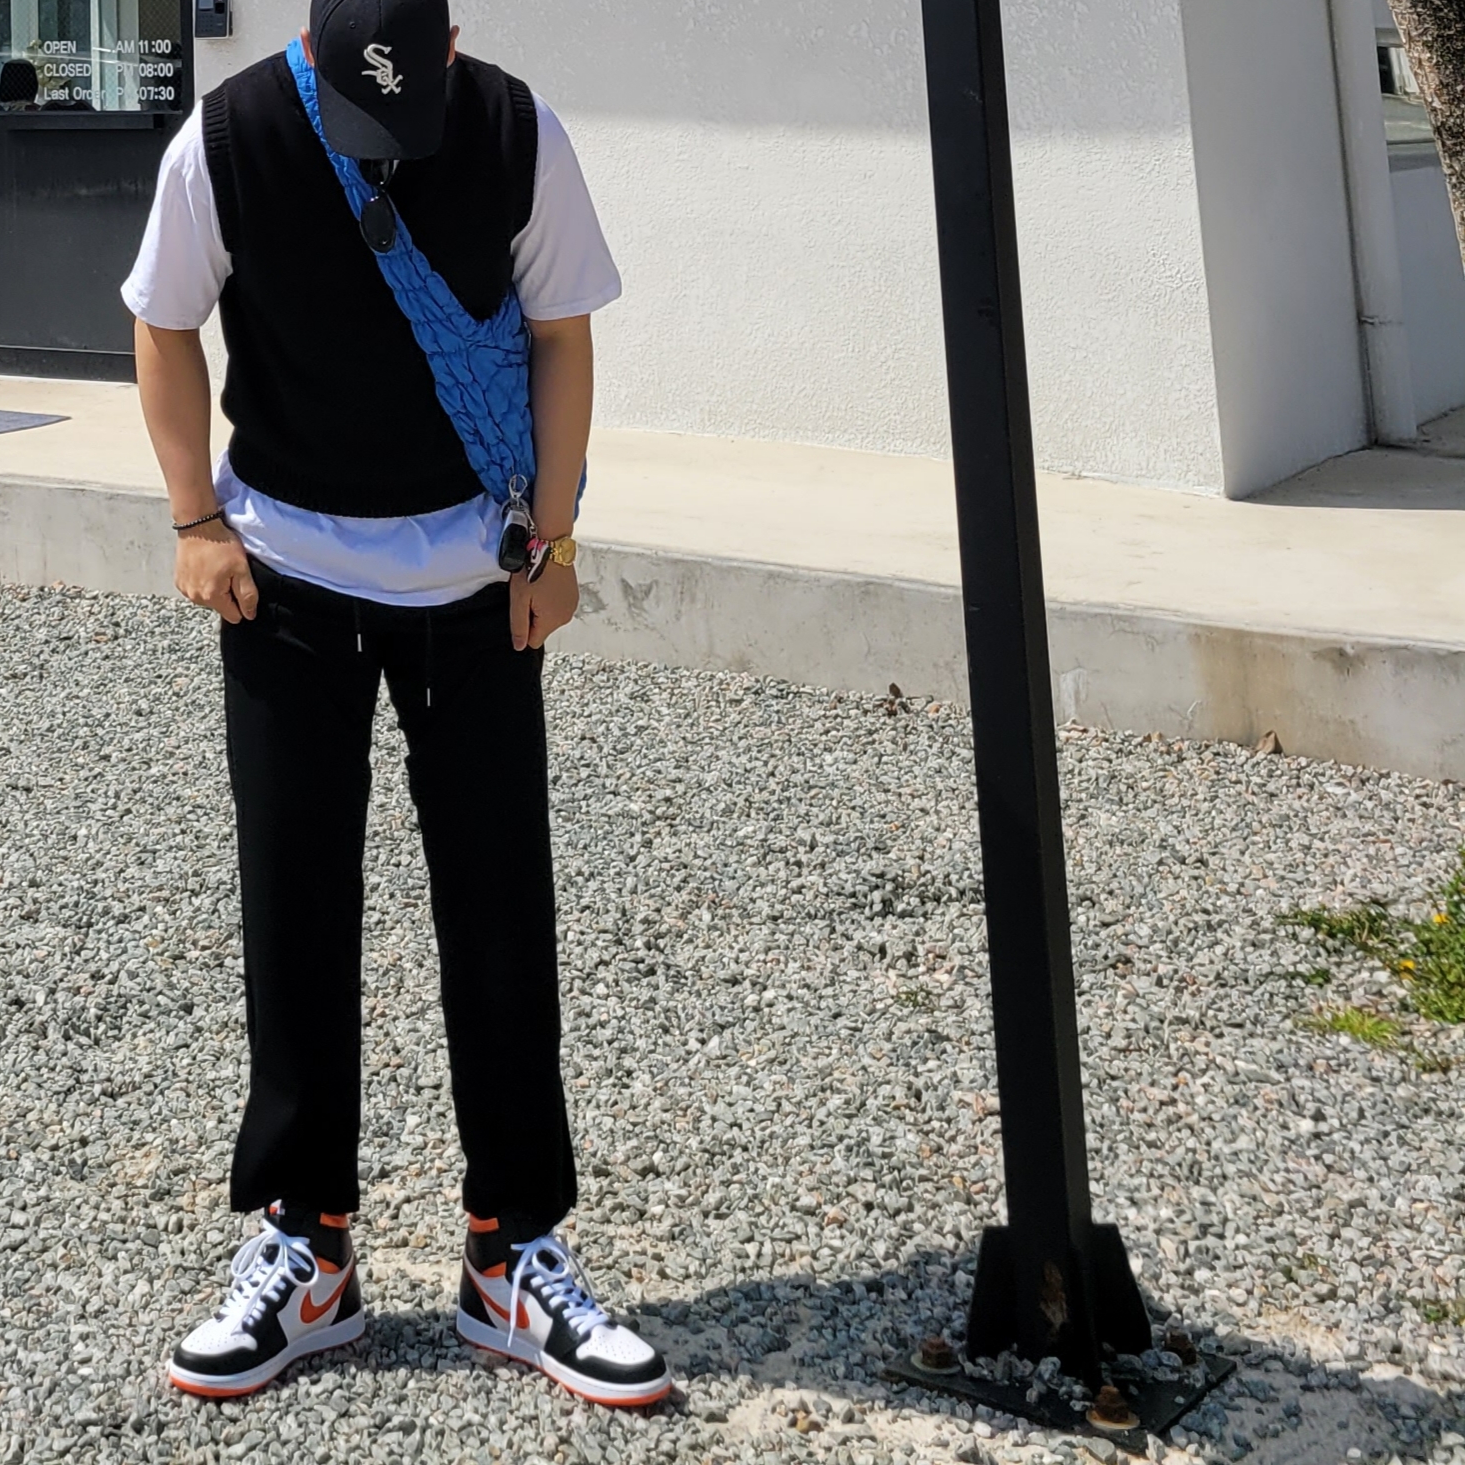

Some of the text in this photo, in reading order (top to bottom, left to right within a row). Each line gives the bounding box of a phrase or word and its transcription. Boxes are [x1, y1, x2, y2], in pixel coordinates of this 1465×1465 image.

[43, 40, 77, 54] OPEN
[115, 40, 135, 54] AM
[43, 63, 92, 77] CLOSED
[138, 62, 174, 77] 08:00
[44, 87, 70, 101] Last
[139, 86, 175, 101] 07:30
